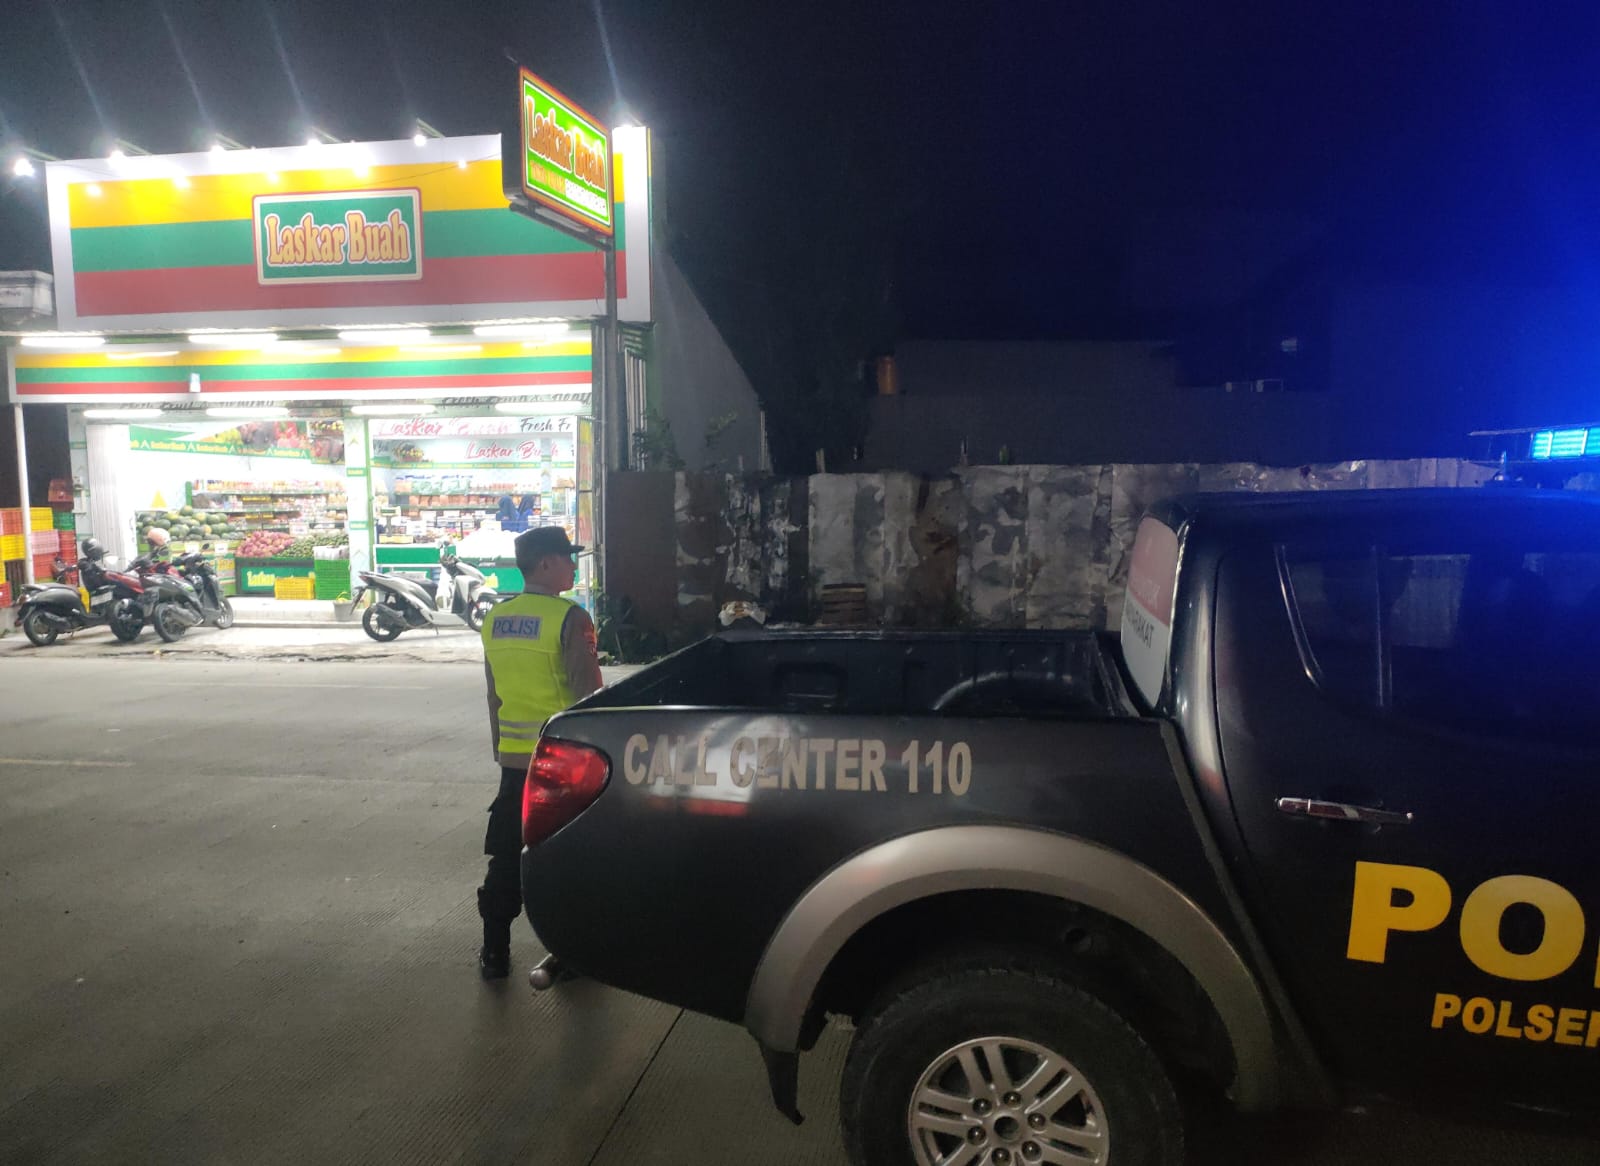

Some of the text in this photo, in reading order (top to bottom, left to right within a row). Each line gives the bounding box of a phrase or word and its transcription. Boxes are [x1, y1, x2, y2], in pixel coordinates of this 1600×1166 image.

[527, 96, 572, 173] Laskar
[266, 210, 410, 266] Laskar Buah
[379, 416, 443, 436] Laskar
[520, 417, 553, 432] Fresh
[466, 441, 512, 459] Laskar
[518, 441, 558, 458] Buh
[494, 619, 540, 636] POLISI
[623, 733, 972, 796] CALL CENTER 110
[1346, 860, 1600, 989] PO
